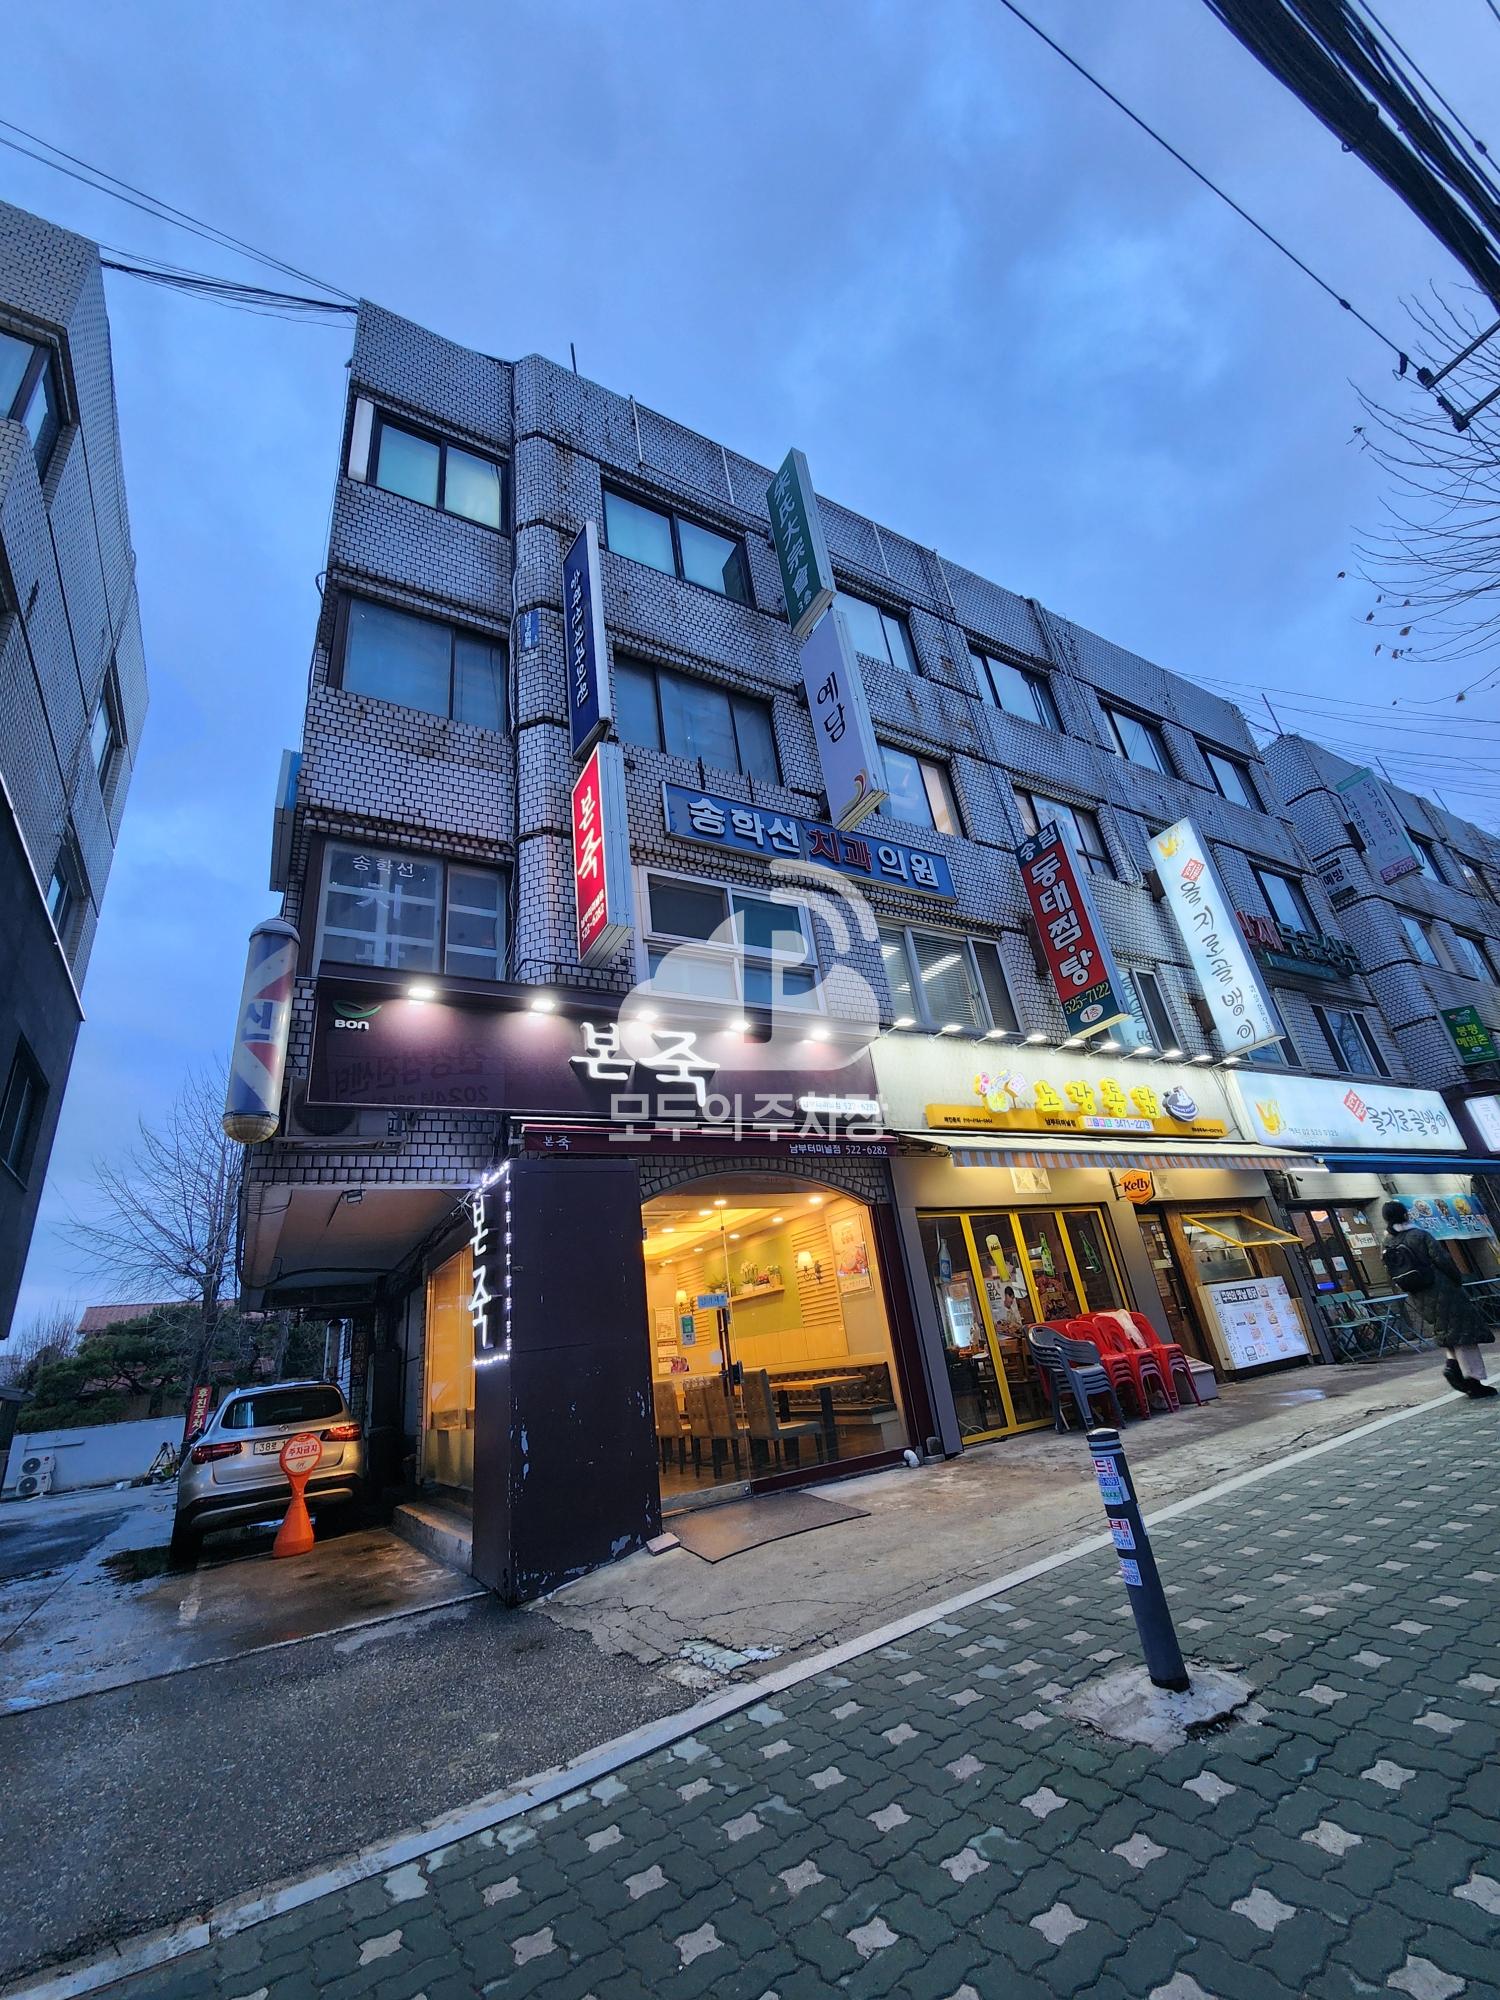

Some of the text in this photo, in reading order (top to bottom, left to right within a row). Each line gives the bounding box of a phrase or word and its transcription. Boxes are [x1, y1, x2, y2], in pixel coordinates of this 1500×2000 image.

[774, 470, 809, 599] 朱氏大宗會
[816, 671, 847, 744] 예담
[577, 785, 602, 880] 본죽
[1019, 823, 1057, 861] 송림
[352, 855, 414, 878] 송학선
[1180, 880, 1256, 1044] 을지로골뱅이
[1065, 982, 1112, 1015] 525-7122
[1082, 1005, 1101, 1022] 1층
[334, 1019, 369, 1030] BON
[568, 1021, 721, 1108] 본죽
[1040, 1078, 1157, 1118] 노랑통닭
[1365, 1106, 1452, 1137] 을지로골뱅이
[543, 1135, 572, 1151] 본죽
[789, 1144, 888, 1155] 남부터미널점 522-6282
[1123, 1177, 1151, 1193] Kelly
[467, 1194, 492, 1349] 본죽
[289, 1444, 318, 1457] 주차금지
